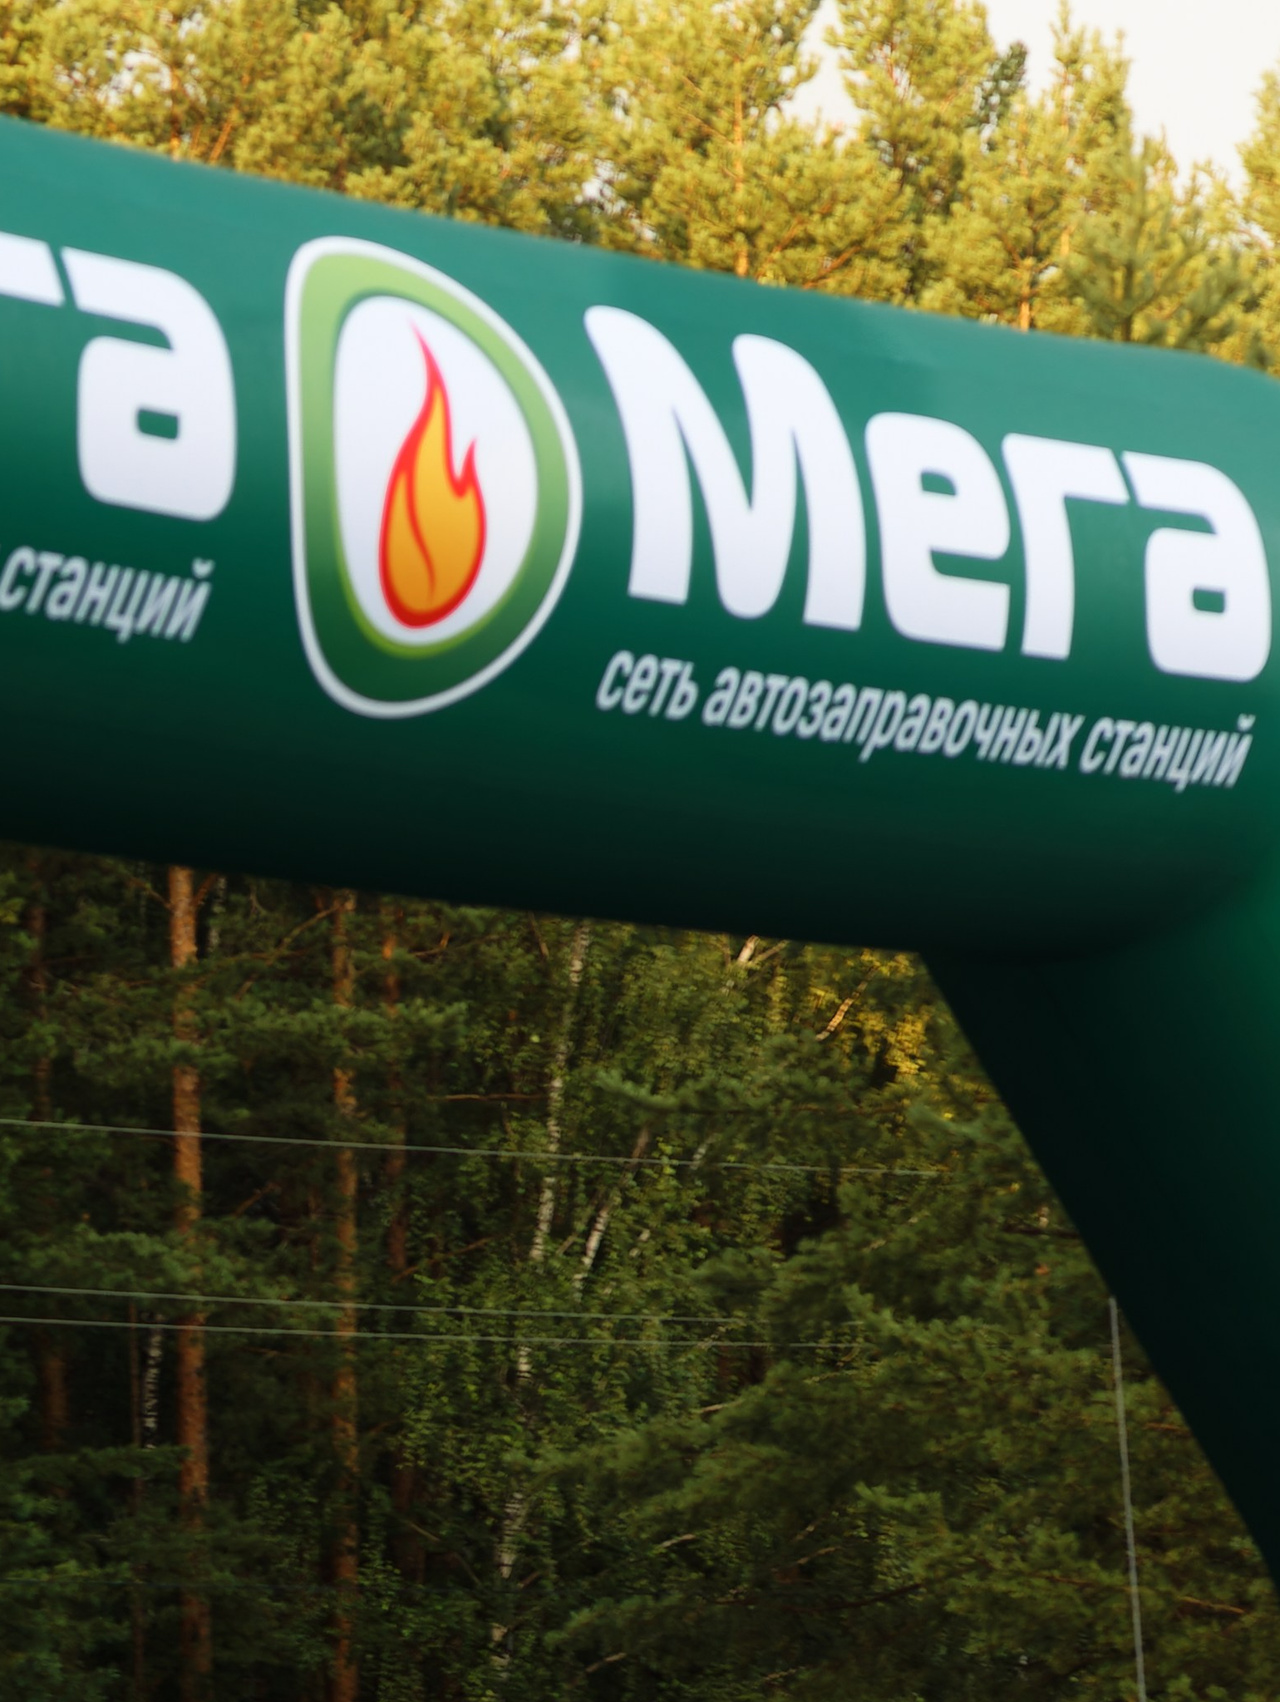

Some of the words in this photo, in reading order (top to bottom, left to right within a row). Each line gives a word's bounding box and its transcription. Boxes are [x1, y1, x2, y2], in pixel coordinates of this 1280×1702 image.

[583, 305, 1272, 682] Мега
[596, 650, 699, 720] сеть
[702, 667, 1085, 770] автозаправочных
[1080, 714, 1255, 792] станций
